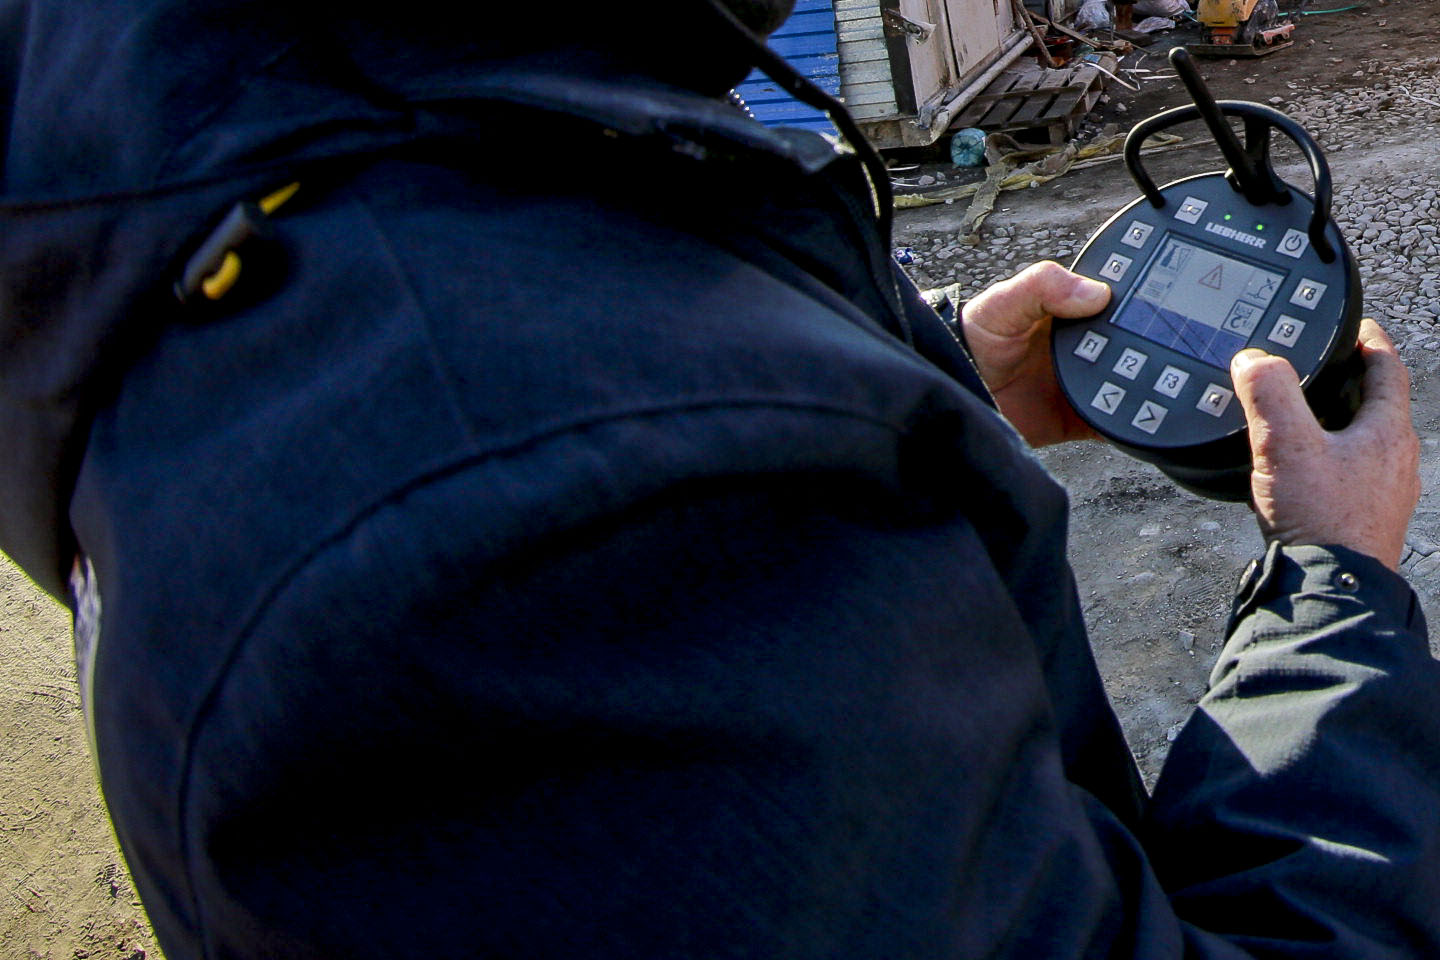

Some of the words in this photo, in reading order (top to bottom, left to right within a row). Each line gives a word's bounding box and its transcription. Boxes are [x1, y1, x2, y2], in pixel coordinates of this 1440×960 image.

[1204, 222, 1267, 249] LIEBHERR
[1277, 322, 1295, 338] F9
[1083, 338, 1099, 353] F1
[1120, 355, 1138, 372] F2
[1162, 372, 1180, 390] F3
